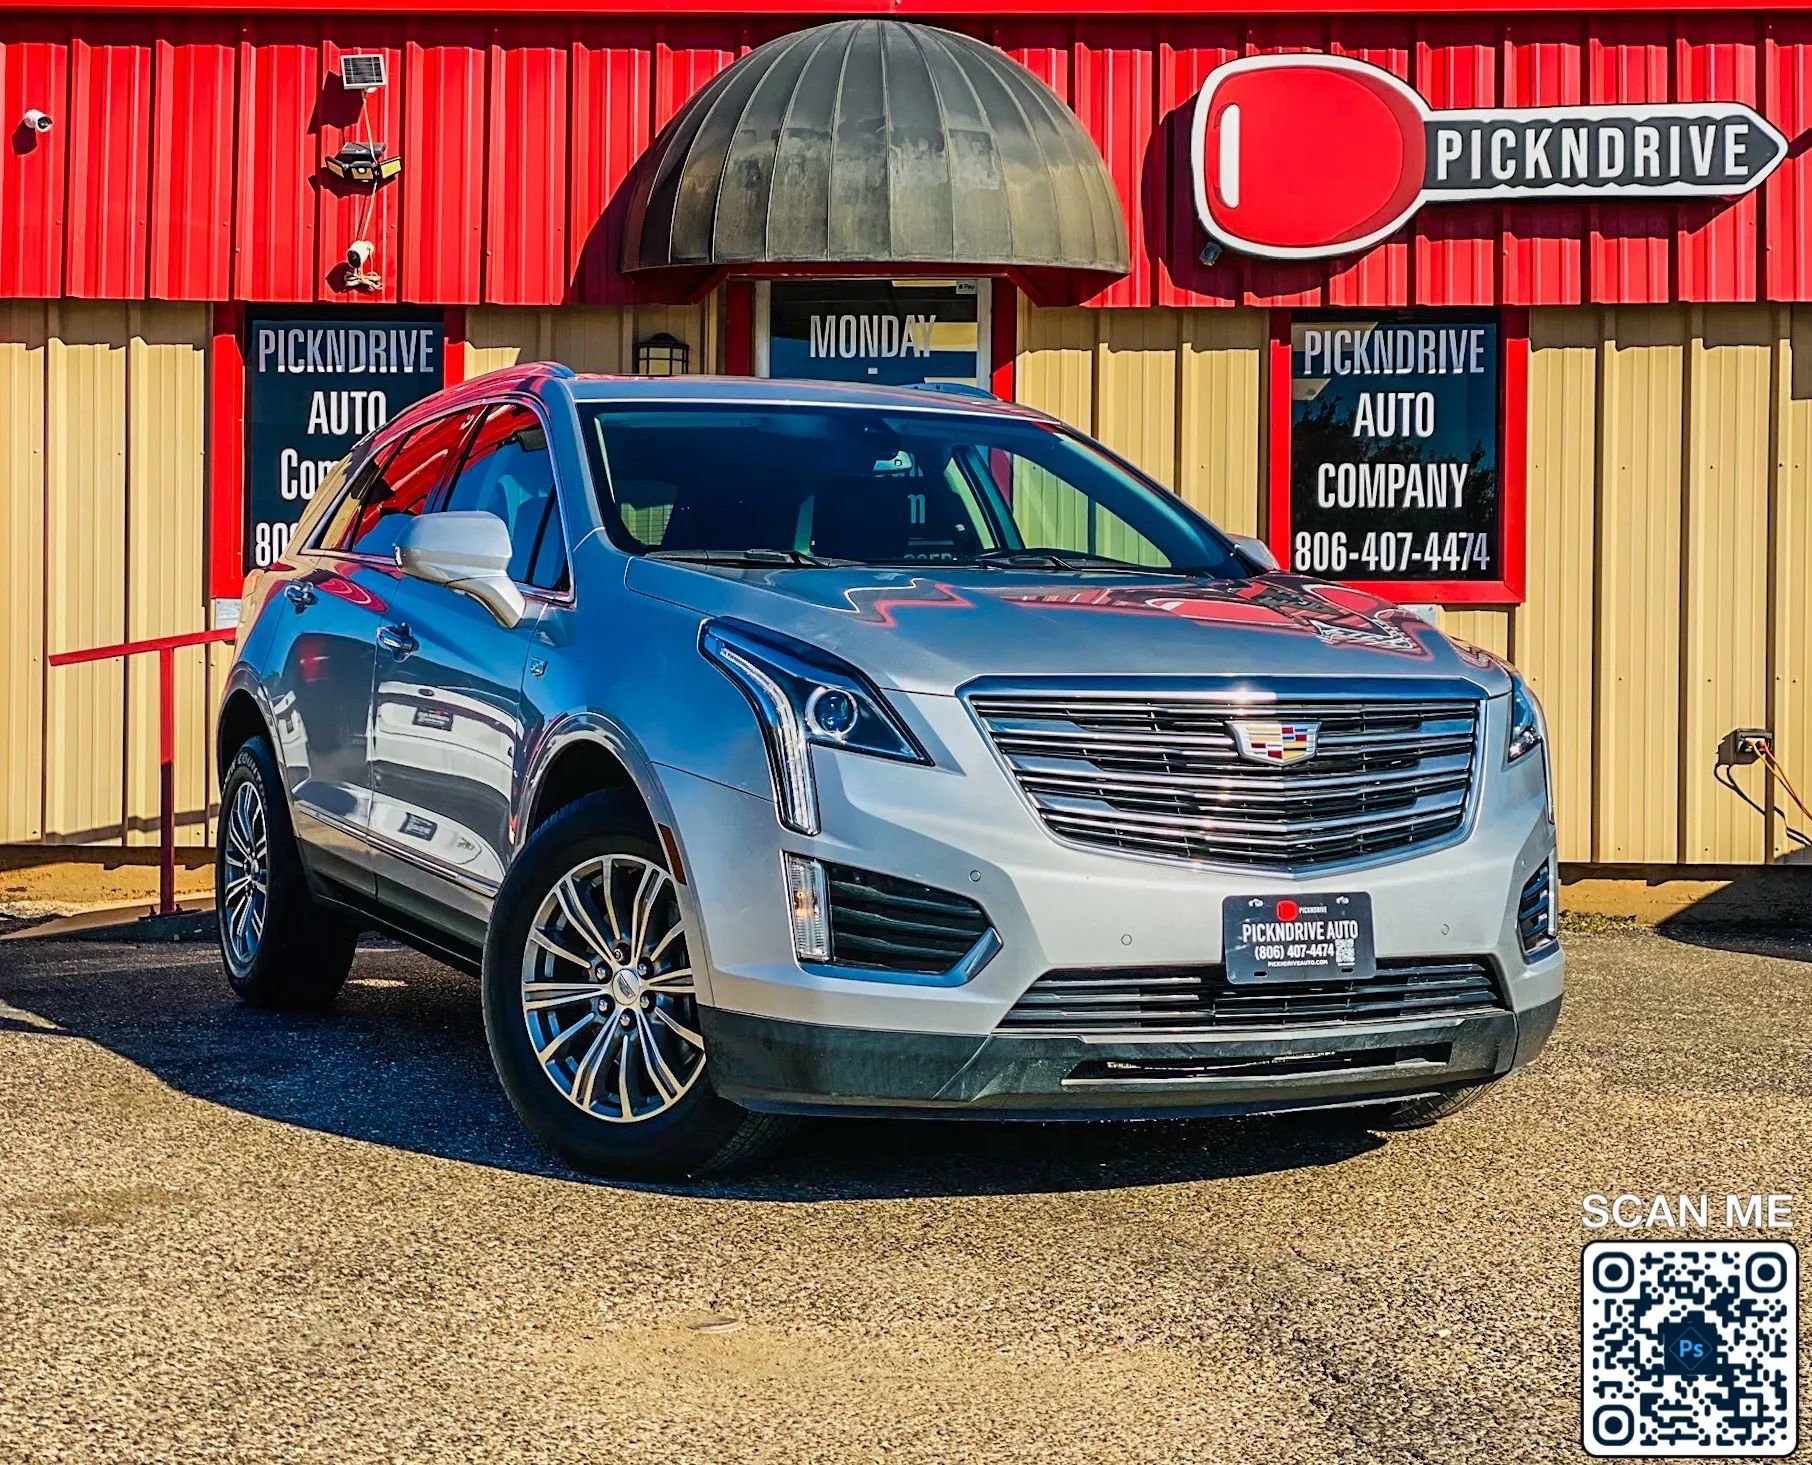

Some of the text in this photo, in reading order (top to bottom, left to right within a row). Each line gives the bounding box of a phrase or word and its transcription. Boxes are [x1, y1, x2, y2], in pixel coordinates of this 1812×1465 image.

[1437, 123, 1749, 181] PICKNDRIVE
[258, 329, 434, 374] PICKNDRIVE
[809, 314, 937, 359] MONDAY
[1303, 329, 1485, 376] PICKNDRIVE
[307, 390, 387, 435] AUTO
[1353, 391, 1436, 438] AUTO
[1317, 462, 1469, 509] COMPANY
[255, 522, 300, 567] 80
[1295, 531, 1490, 572] 806-407-4474
[1241, 919, 1359, 943] PICKNDRIVE AUTO
[1254, 942, 1335, 961] (806) 407-4474
